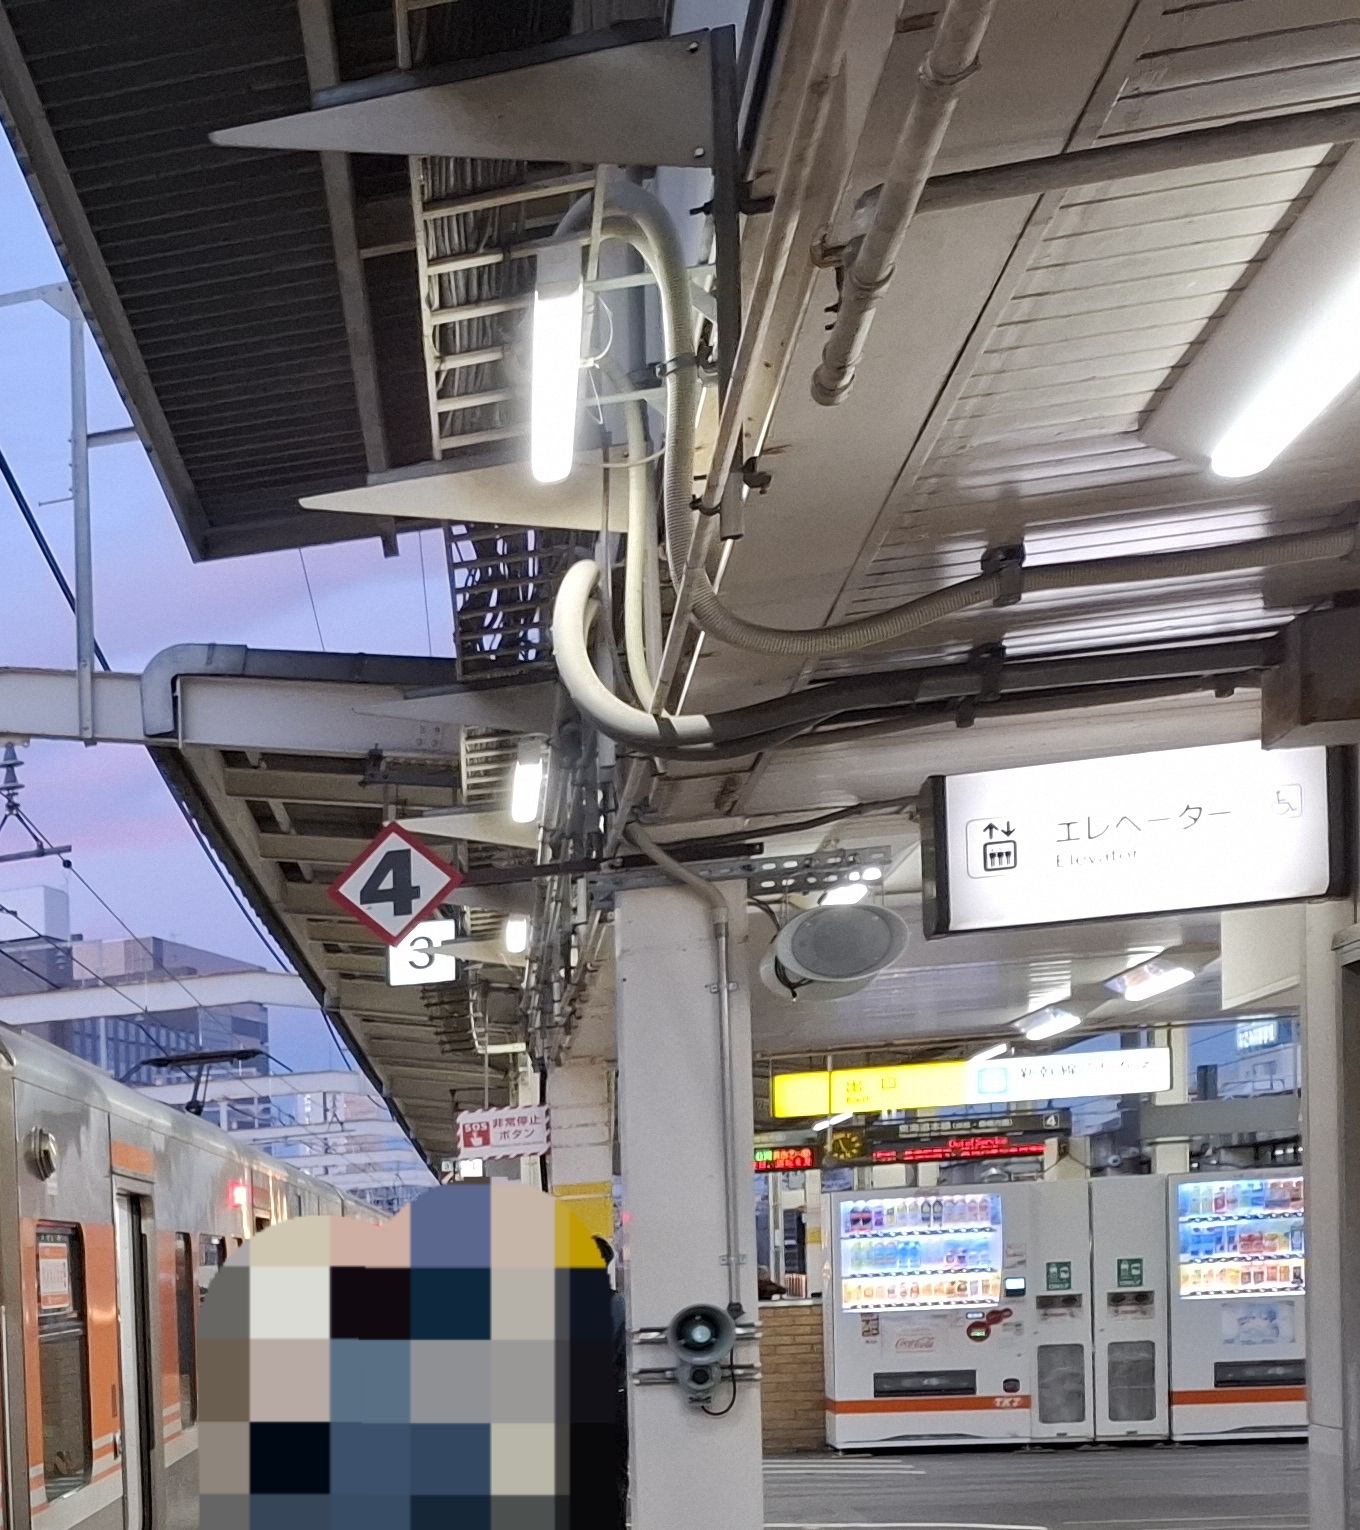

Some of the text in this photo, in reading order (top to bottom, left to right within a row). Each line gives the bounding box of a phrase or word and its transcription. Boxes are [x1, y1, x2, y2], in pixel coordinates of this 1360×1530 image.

[360, 849, 421, 916] 4
[408, 936, 435, 970] 3
[492, 1115, 541, 1128] 非常停止
[1045, 1114, 1057, 1126] 4
[464, 1122, 488, 1133] SOS
[499, 1129, 535, 1140] ボタン
